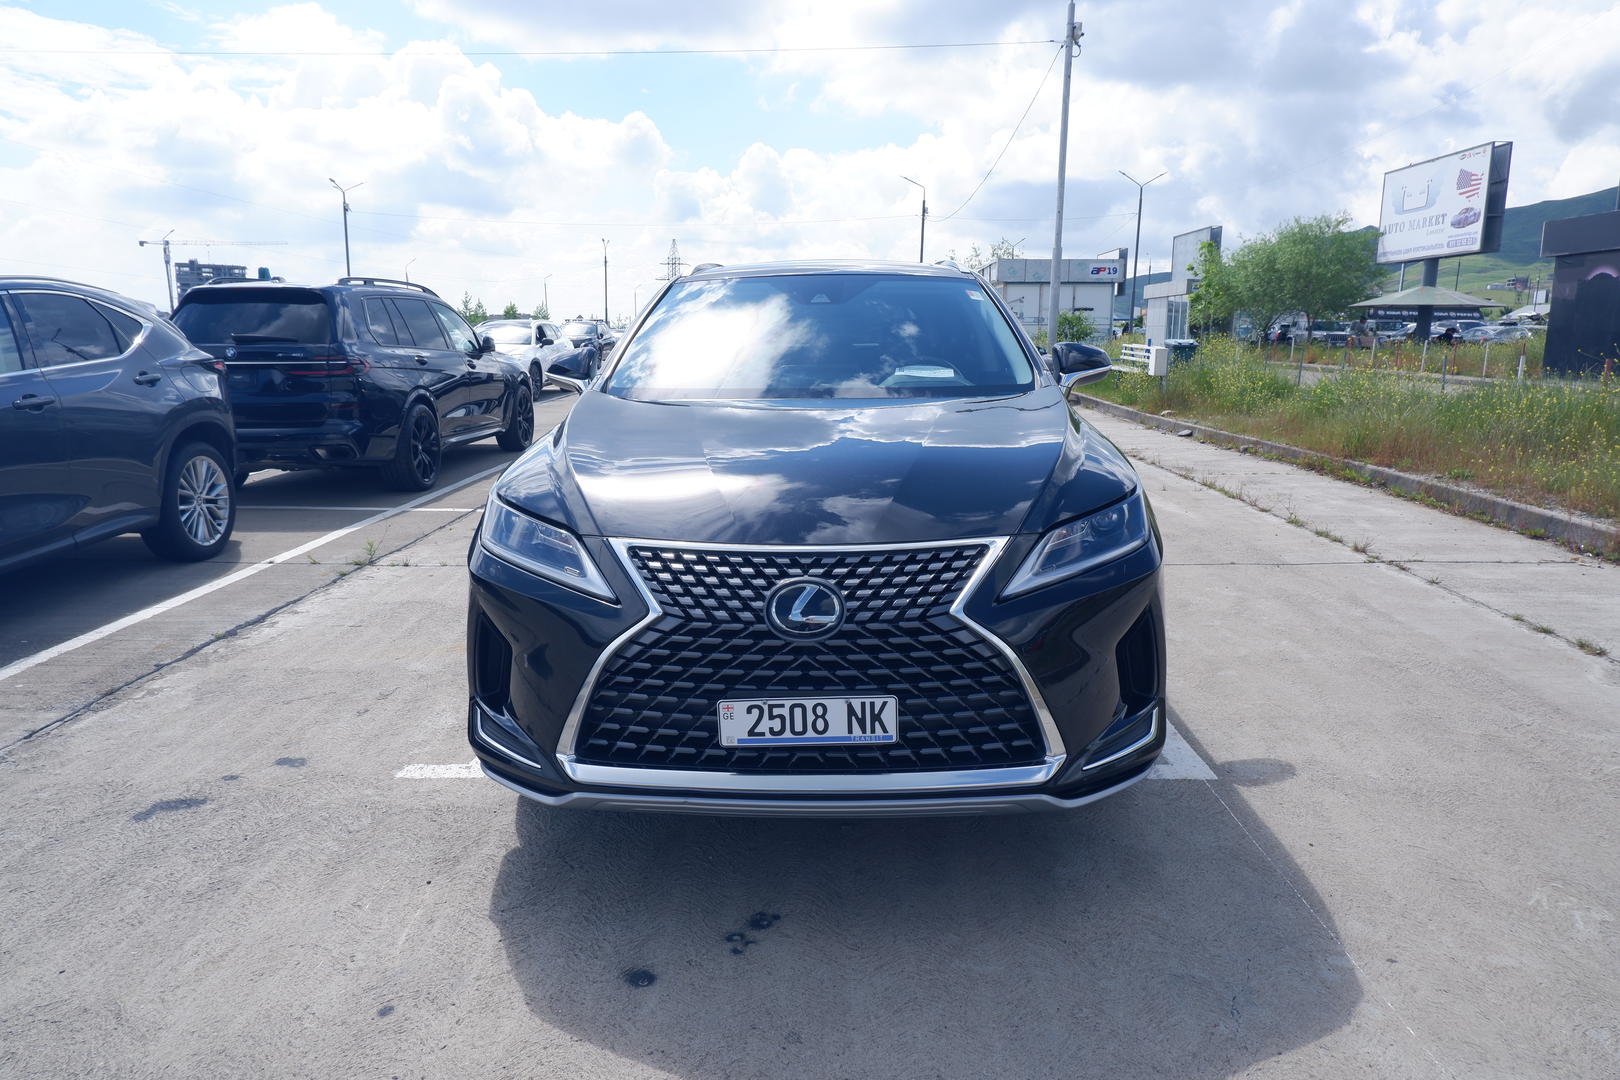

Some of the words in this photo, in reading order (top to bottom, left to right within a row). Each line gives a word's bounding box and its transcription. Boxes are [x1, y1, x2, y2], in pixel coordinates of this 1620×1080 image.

[1382, 222, 1405, 235] AUTO
[1407, 213, 1447, 231] MARKET
[1107, 266, 1118, 275] 19
[722, 712, 735, 720] GE
[746, 702, 829, 737] 2508
[846, 700, 889, 735] NK
